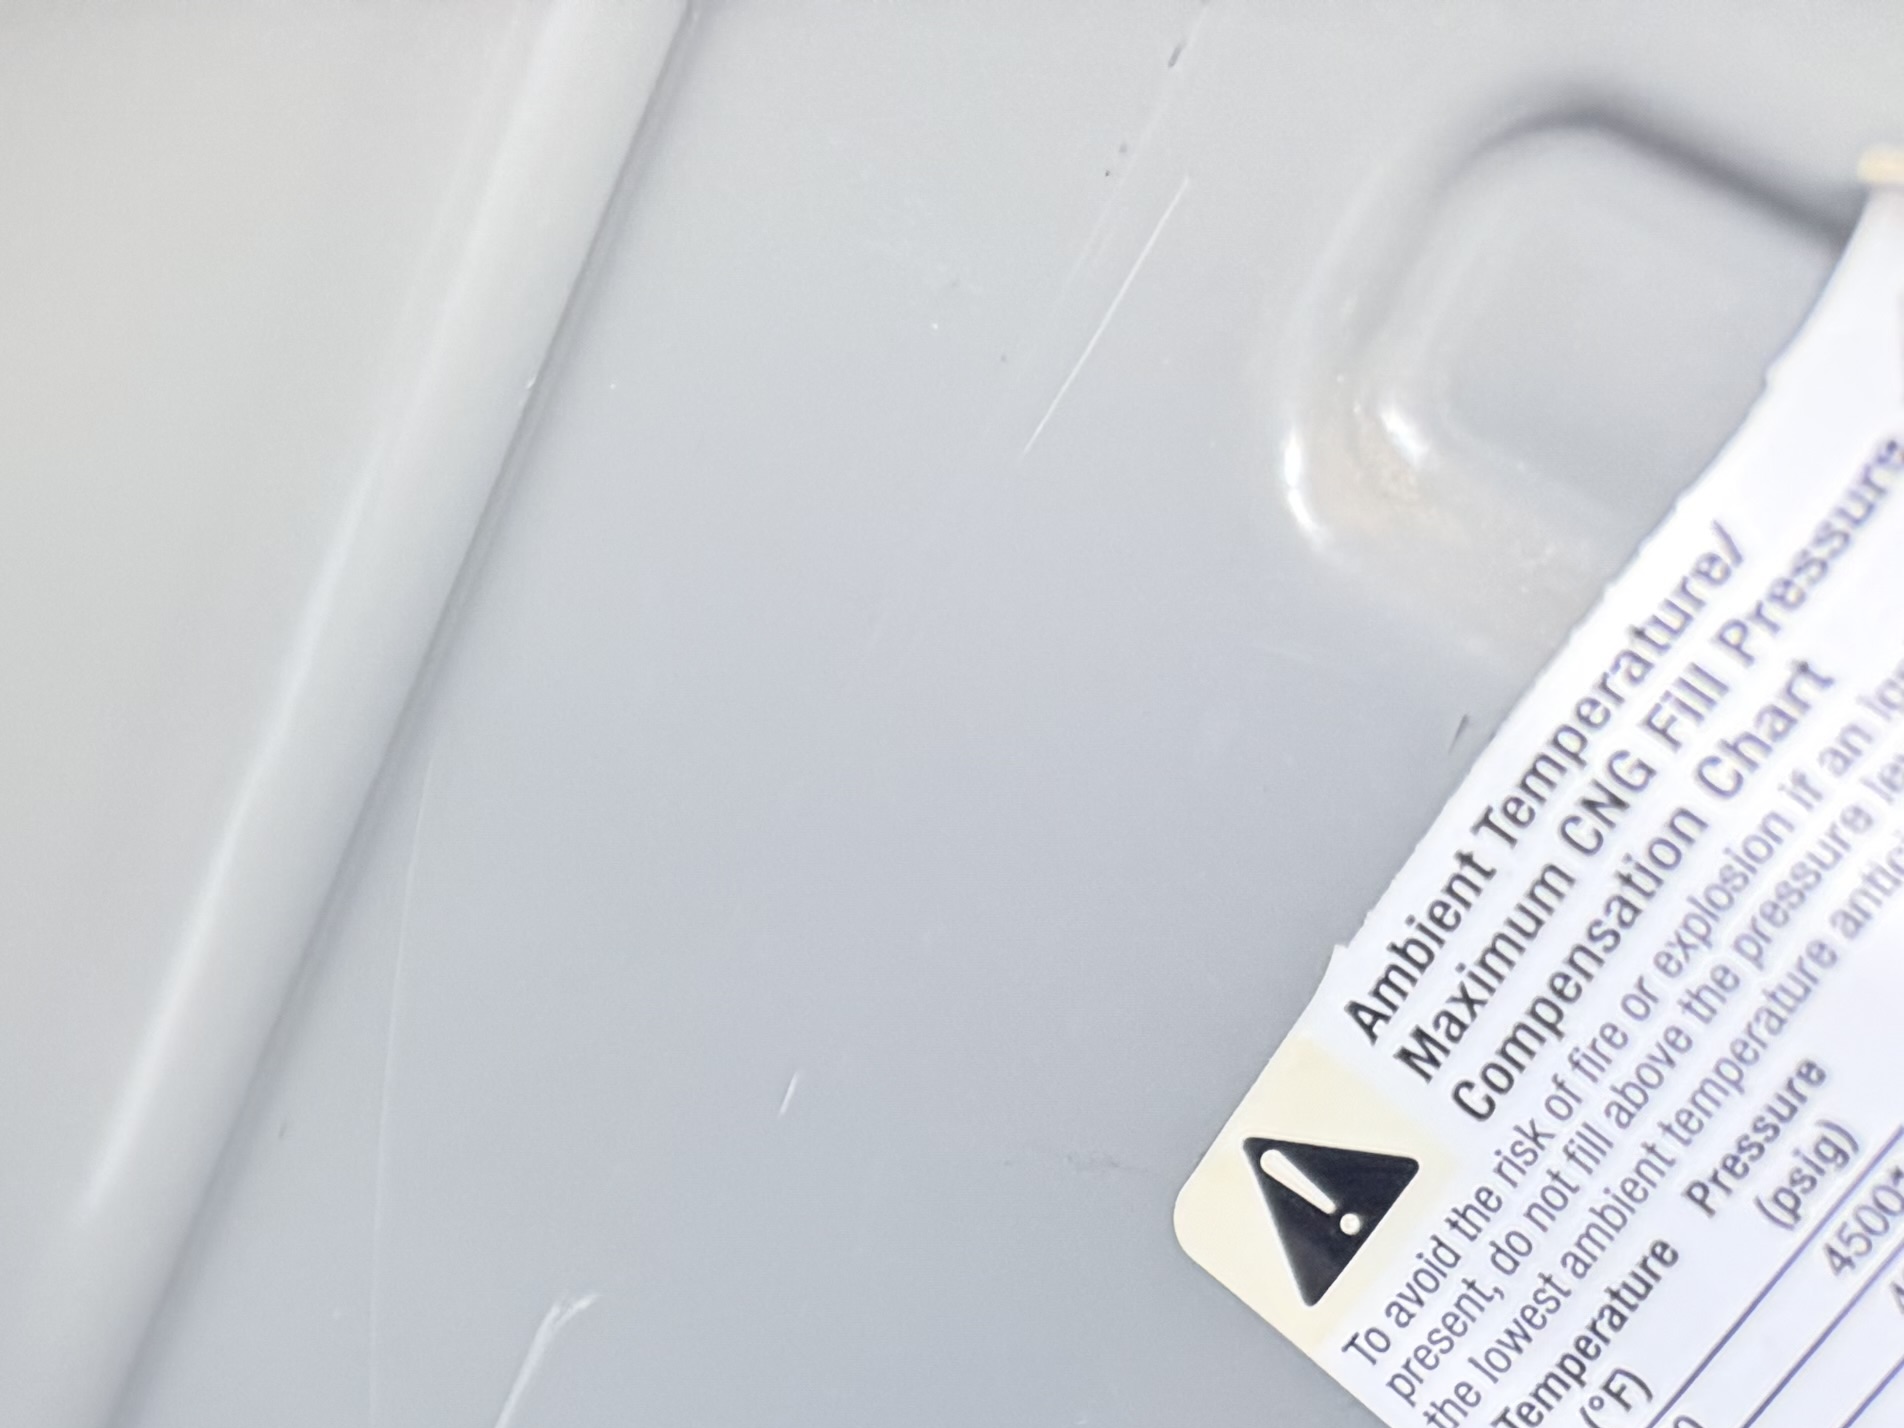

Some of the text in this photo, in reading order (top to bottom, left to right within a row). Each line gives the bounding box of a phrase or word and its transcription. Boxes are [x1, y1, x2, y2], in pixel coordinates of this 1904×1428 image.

[1345, 522, 1743, 1045] Ambient Temperature/
[1395, 864, 1576, 1083] Maximum
[1560, 751, 1656, 856] CNG
[1641, 663, 1729, 752] Fill
[1452, 660, 1835, 1122] Compensation Chart
[1342, 1327, 1391, 1365] To
[1385, 1235, 1461, 1328] avoid
[1445, 1187, 1502, 1242] the
[1493, 1118, 1556, 1188] risk
[1545, 1073, 1583, 1121] of
[1568, 1023, 1629, 1083] fire
[1621, 975, 1659, 1021] or
[1653, 812, 1794, 979] explosion
[1779, 770, 1823, 811] if
[1818, 723, 1874, 777] an
[1386, 1278, 1504, 1408] present,
[1489, 1231, 1532, 1275] do
[1524, 1169, 1580, 1232] not
[1563, 1122, 1613, 1175] fill
[1604, 1026, 1693, 1130] above
[1678, 965, 1740, 1024] the
[1731, 806, 1874, 972] pressure
[1468, 1272, 1572, 1384] lowest
[1560, 1142, 1676, 1280] ambient
[1658, 940, 1838, 1147] temperature
[1683, 1060, 1826, 1218] Pressure
[1755, 1120, 1859, 1231] (psig)
